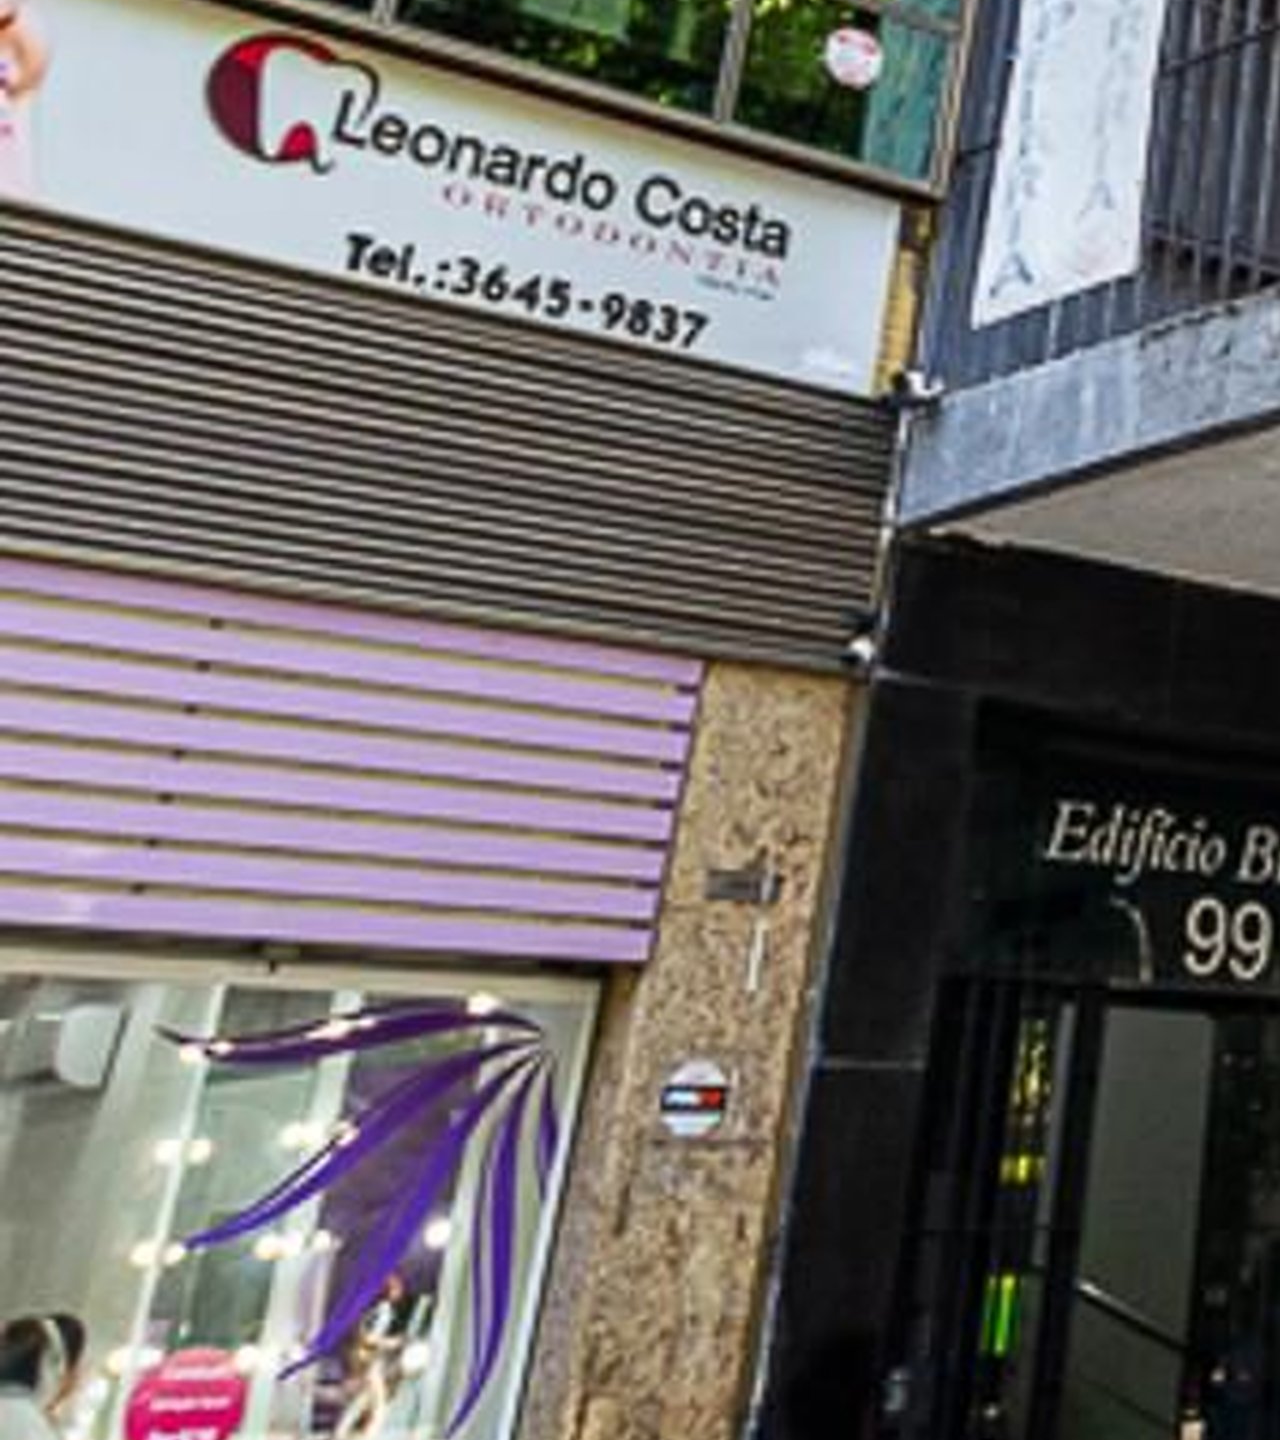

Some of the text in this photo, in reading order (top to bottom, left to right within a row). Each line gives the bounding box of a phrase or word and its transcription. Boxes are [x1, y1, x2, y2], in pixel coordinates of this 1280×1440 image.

[331, 88, 792, 259] Leonardo Costa
[442, 182, 782, 287] ORTODONTIA
[1181, 895, 1274, 981] 99
